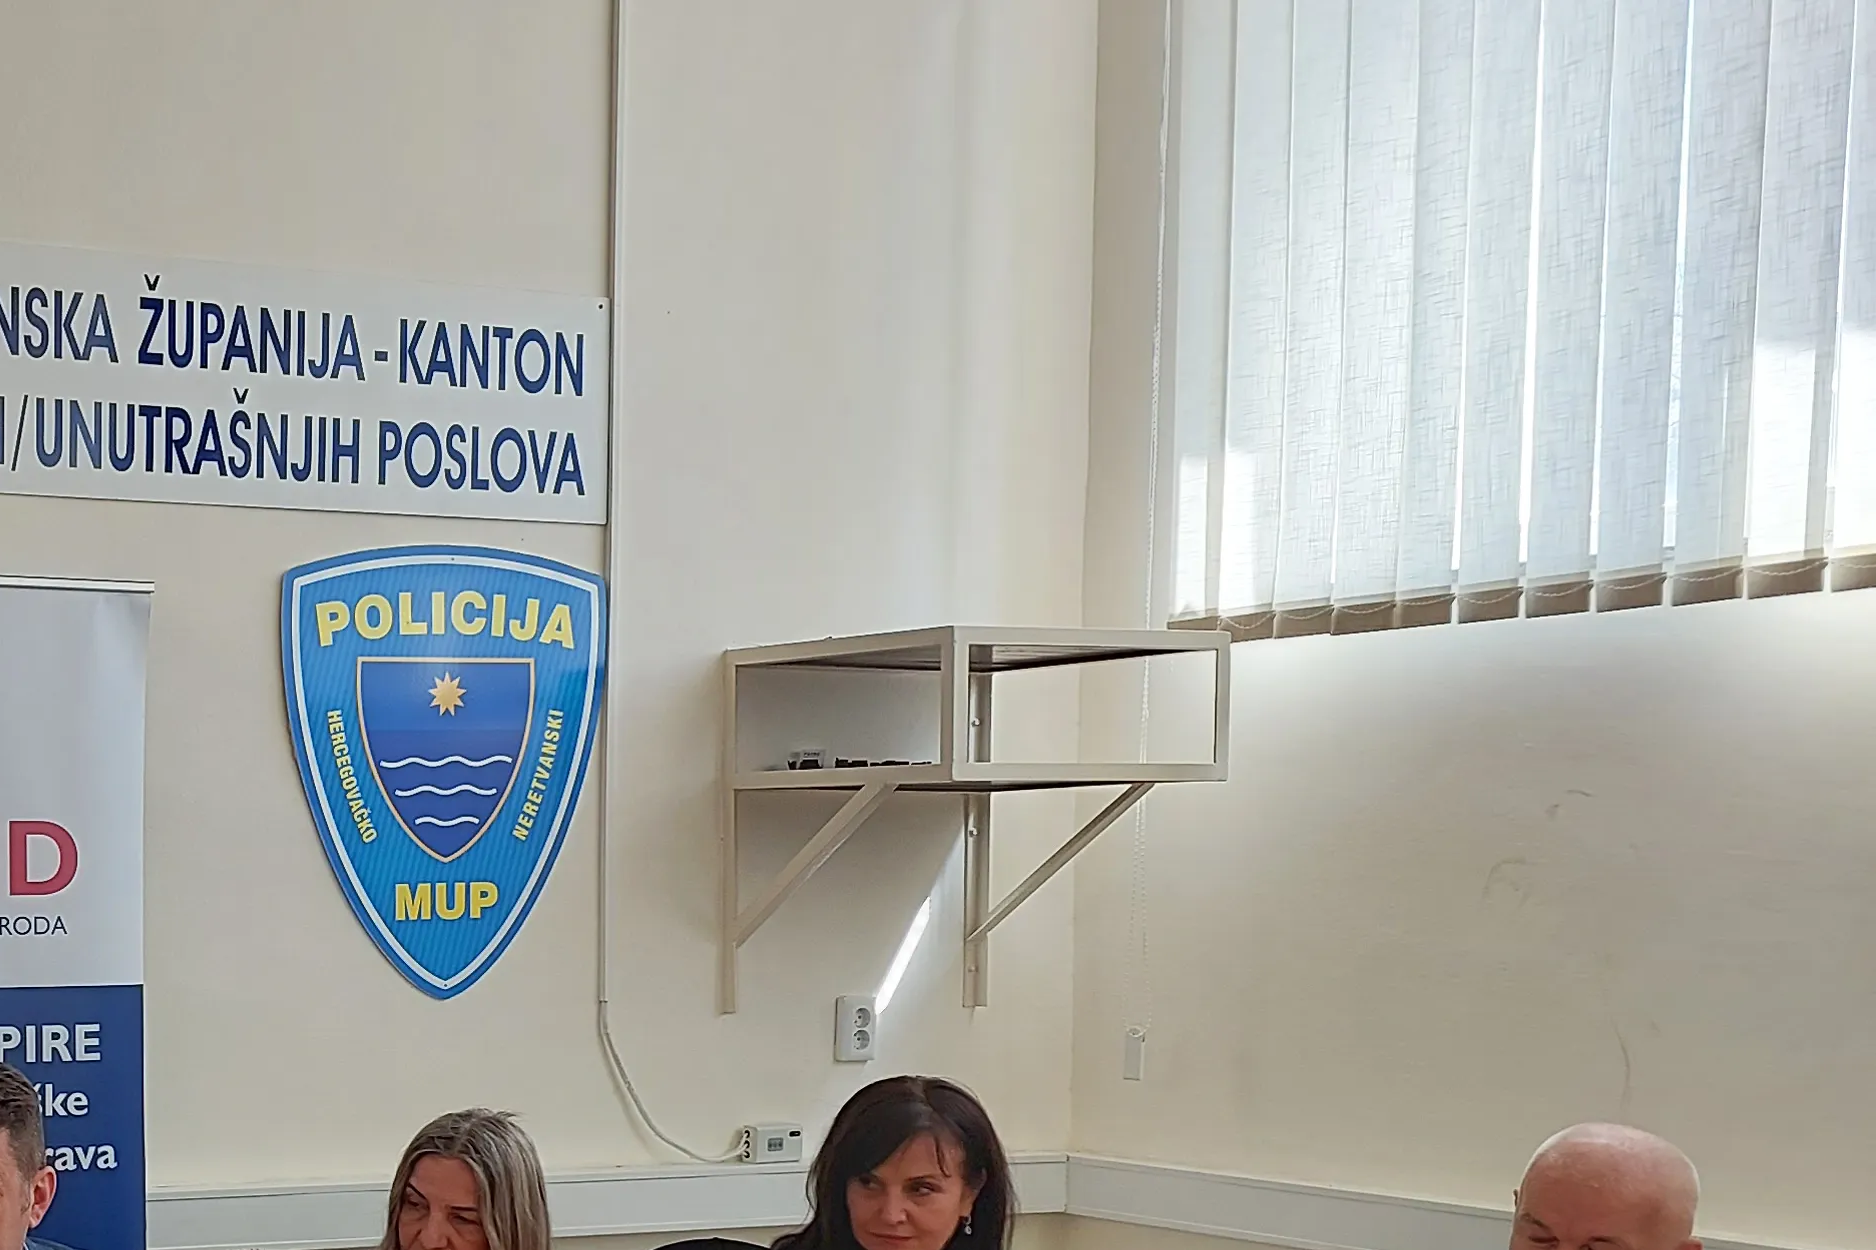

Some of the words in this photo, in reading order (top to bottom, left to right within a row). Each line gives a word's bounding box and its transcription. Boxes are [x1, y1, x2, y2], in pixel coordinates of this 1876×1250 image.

[377, 420, 585, 496] POSLOVA
[315, 591, 575, 650] POLICIJA
[327, 710, 378, 844] HERCEGOVAČKO
[513, 710, 564, 842] NERETVANSKI
[395, 882, 499, 921] MUP
[44, 1144, 118, 1171] rava
